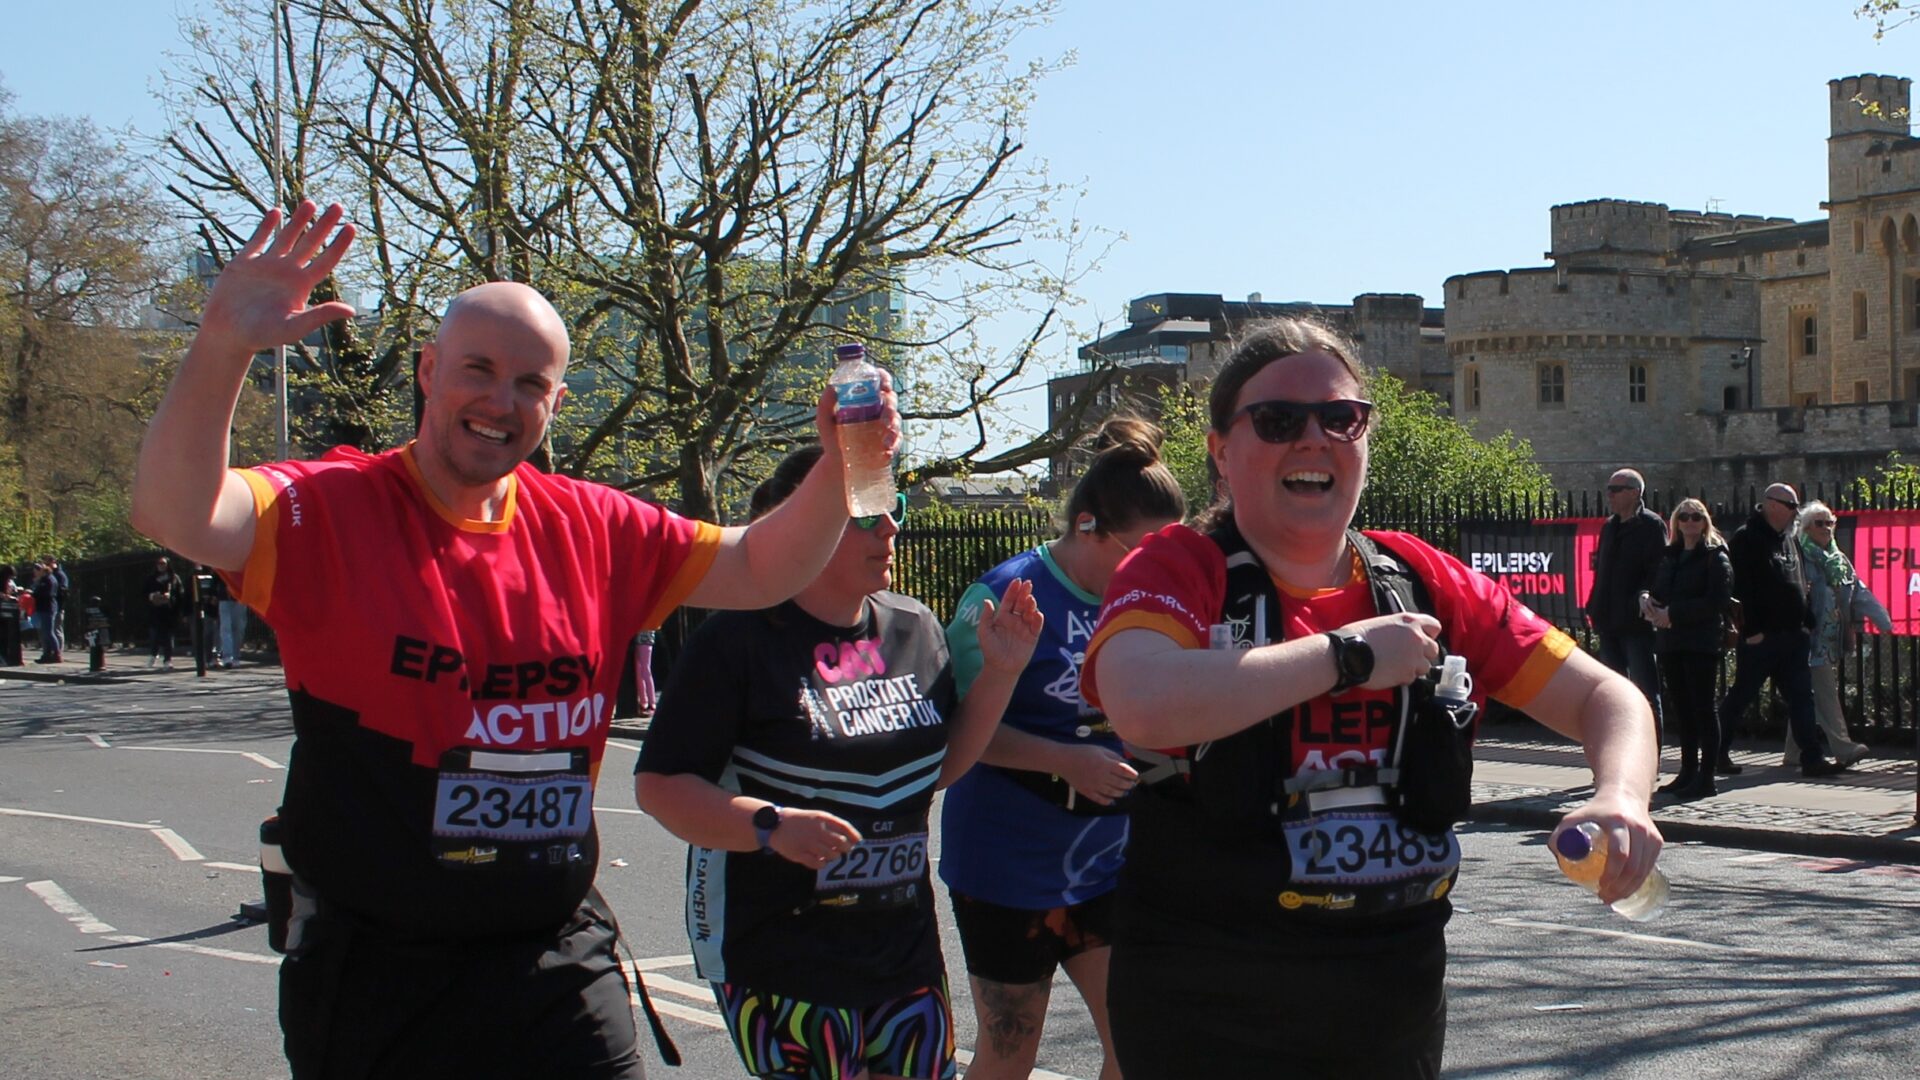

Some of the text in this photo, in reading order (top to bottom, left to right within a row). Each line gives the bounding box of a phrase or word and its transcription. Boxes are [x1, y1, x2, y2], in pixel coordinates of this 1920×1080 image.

[1471, 552, 1553, 573] EPILEPSY
[1500, 573, 1565, 595] ACTION
[390, 634, 602, 700] EPEPSY
[814, 637, 885, 683] CAT
[825, 673, 923, 712] PROSTATE
[838, 699, 942, 738] CANCER UK
[445, 784, 583, 830] 23487
[872, 821, 894, 832] CAT
[825, 841, 924, 881] 22766
[1300, 823, 1451, 875] 23489
[693, 858, 708, 921] CANCER
[696, 922, 711, 943] UK
